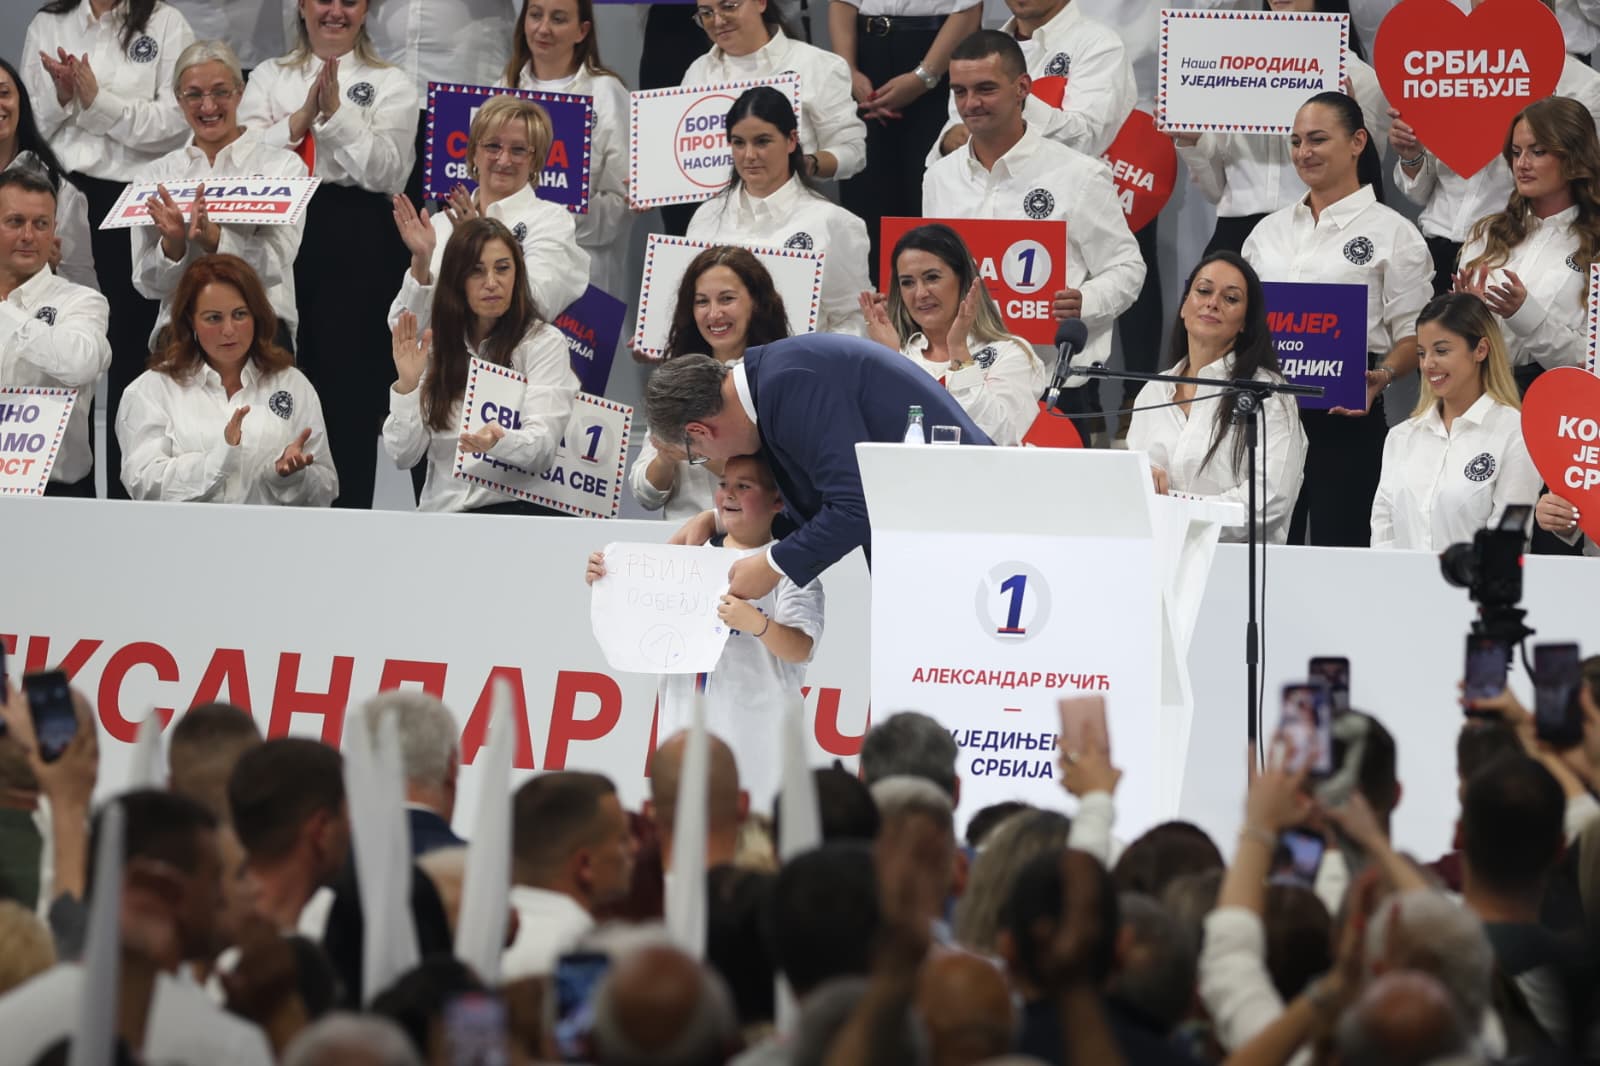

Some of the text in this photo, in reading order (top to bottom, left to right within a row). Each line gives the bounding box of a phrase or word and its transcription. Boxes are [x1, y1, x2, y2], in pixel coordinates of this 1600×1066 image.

[1181, 55, 1325, 75] Наша ПОРОДИЦА,
[1403, 48, 1530, 75] СРБИЈА
[1180, 75, 1324, 90] УЈЕДИЊЕНА СРБИЈА
[1403, 77, 1530, 98] ПОБЕЂУЈЕ
[679, 132, 732, 152] ПРОТ
[683, 154, 735, 170] НАСИЉ
[206, 201, 276, 213] ПЦИЈА
[1016, 248, 1036, 287] 1
[1006, 300, 1049, 320] СВЕ
[1277, 340, 1304, 351] као
[1277, 359, 1343, 379] ДНИК!
[1557, 415, 1600, 442] КО
[0, 432, 46, 453] МО
[581, 425, 603, 463] 1
[569, 471, 608, 498] СВЕ
[997, 574, 1027, 635] 1
[911, 667, 1110, 691] АЛЕКСАНДАР ВУЧИЋ
[951, 729, 1059, 752] ЈЕДИЊЕ
[970, 758, 1054, 779] СРБИЈА
